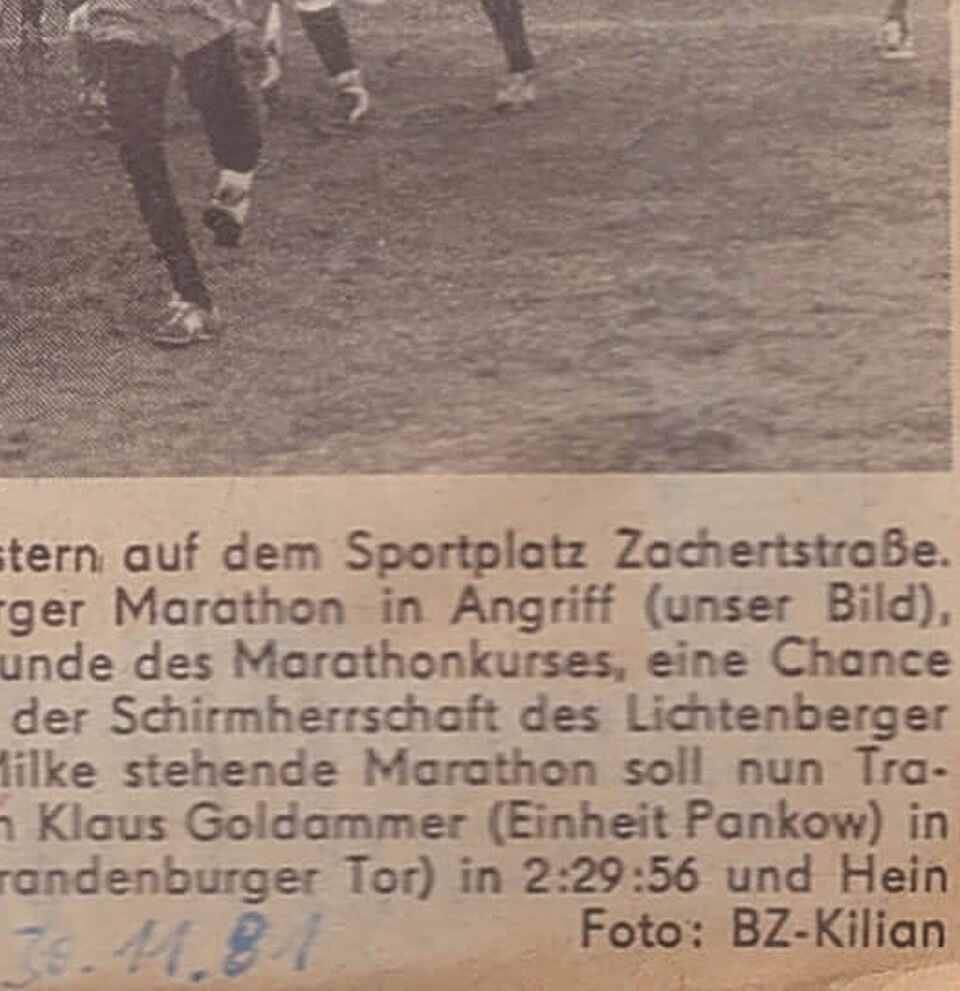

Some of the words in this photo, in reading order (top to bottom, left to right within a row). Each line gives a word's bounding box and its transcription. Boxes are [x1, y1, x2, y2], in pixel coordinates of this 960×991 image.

[122, 531, 200, 573] auf
[221, 531, 321, 571] dem
[344, 529, 588, 579] Sportplatz
[614, 527, 951, 569] Zachertstraße.
[114, 586, 345, 626] Marathon
[382, 588, 423, 623] in
[450, 583, 615, 634] Angriff
[645, 583, 793, 629] (unser
[827, 581, 951, 629] Bild),
[133, 640, 214, 681] des
[233, 639, 626, 681] Marathonkurses,
[646, 640, 749, 678] eine
[770, 635, 953, 678] Chance
[11, 696, 89, 735] der
[109, 693, 500, 735] Schirmherrschaft
[519, 694, 601, 733] des
[627, 692, 950, 741] Lichtenberger
[123, 749, 338, 788] stehende
[364, 748, 596, 787] Marathon
[623, 746, 702, 786] soll
[737, 759, 823, 785] nun
[855, 745, 948, 785] Tra-
[38, 803, 167, 841] Klaus
[184, 801, 467, 842] Goldammer
[488, 800, 670, 846] (Einheit
[685, 798, 883, 846] Pankow)
[909, 802, 949, 839] in
[344, 855, 435, 900] Tor)
[460, 857, 503, 893] in
[522, 855, 700, 894] 2:29:56
[726, 853, 813, 893] und
[840, 853, 948, 894] Hein
[580, 907, 703, 948] Foto:
[732, 907, 946, 949] BZ-Kilian
